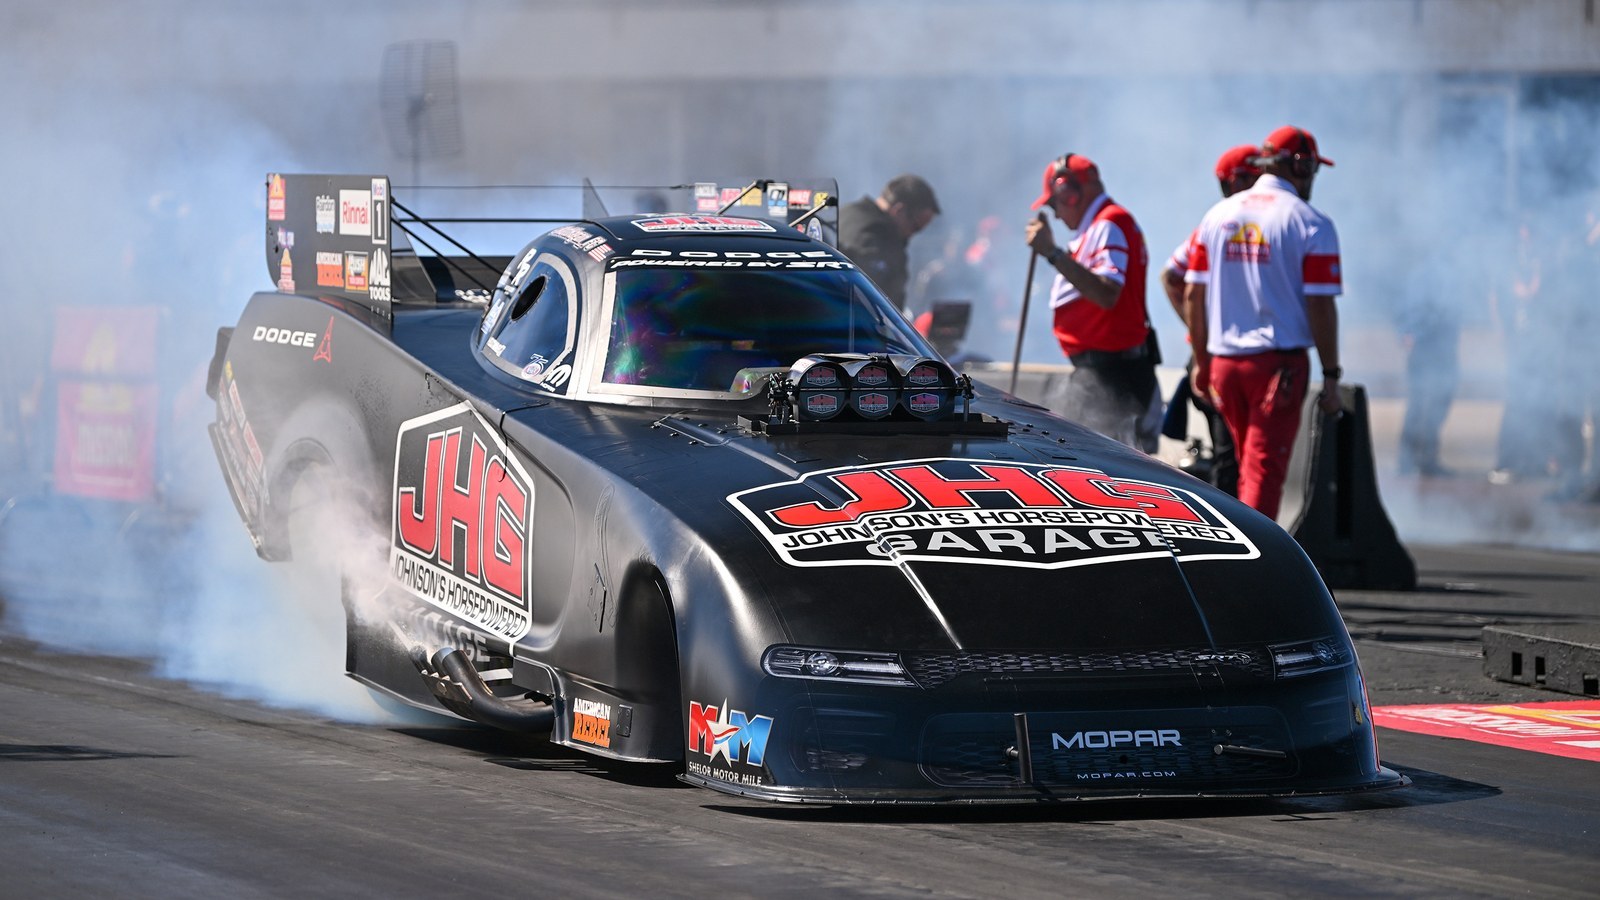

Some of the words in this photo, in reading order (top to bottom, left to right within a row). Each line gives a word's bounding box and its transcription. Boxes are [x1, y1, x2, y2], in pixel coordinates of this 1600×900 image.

[342, 201, 369, 224] Rinnai
[610, 259, 743, 269] POWERED
[785, 261, 855, 269] SRT
[631, 249, 833, 259] DODGE
[369, 248, 390, 287] MAC
[369, 287, 390, 301] TOOLS
[253, 326, 317, 348] DODGE
[765, 464, 1211, 528] JHG
[399, 426, 527, 605] JHG
[782, 512, 970, 549] JOHNSON'S
[973, 509, 1236, 542] HORSEPOWERED
[865, 529, 1181, 557] GARAGE
[392, 553, 447, 603] JOHNSON'S
[446, 578, 528, 639] HORSEPOWERED
[573, 697, 611, 718] AMERICAN
[572, 713, 611, 748] REBEL
[1051, 729, 1183, 750] MOPAR
[688, 761, 713, 777] SHELOR
[712, 767, 740, 785] MOTOR
[741, 773, 763, 787] MILE
[1076, 770, 1177, 780] MOPAR.COM
